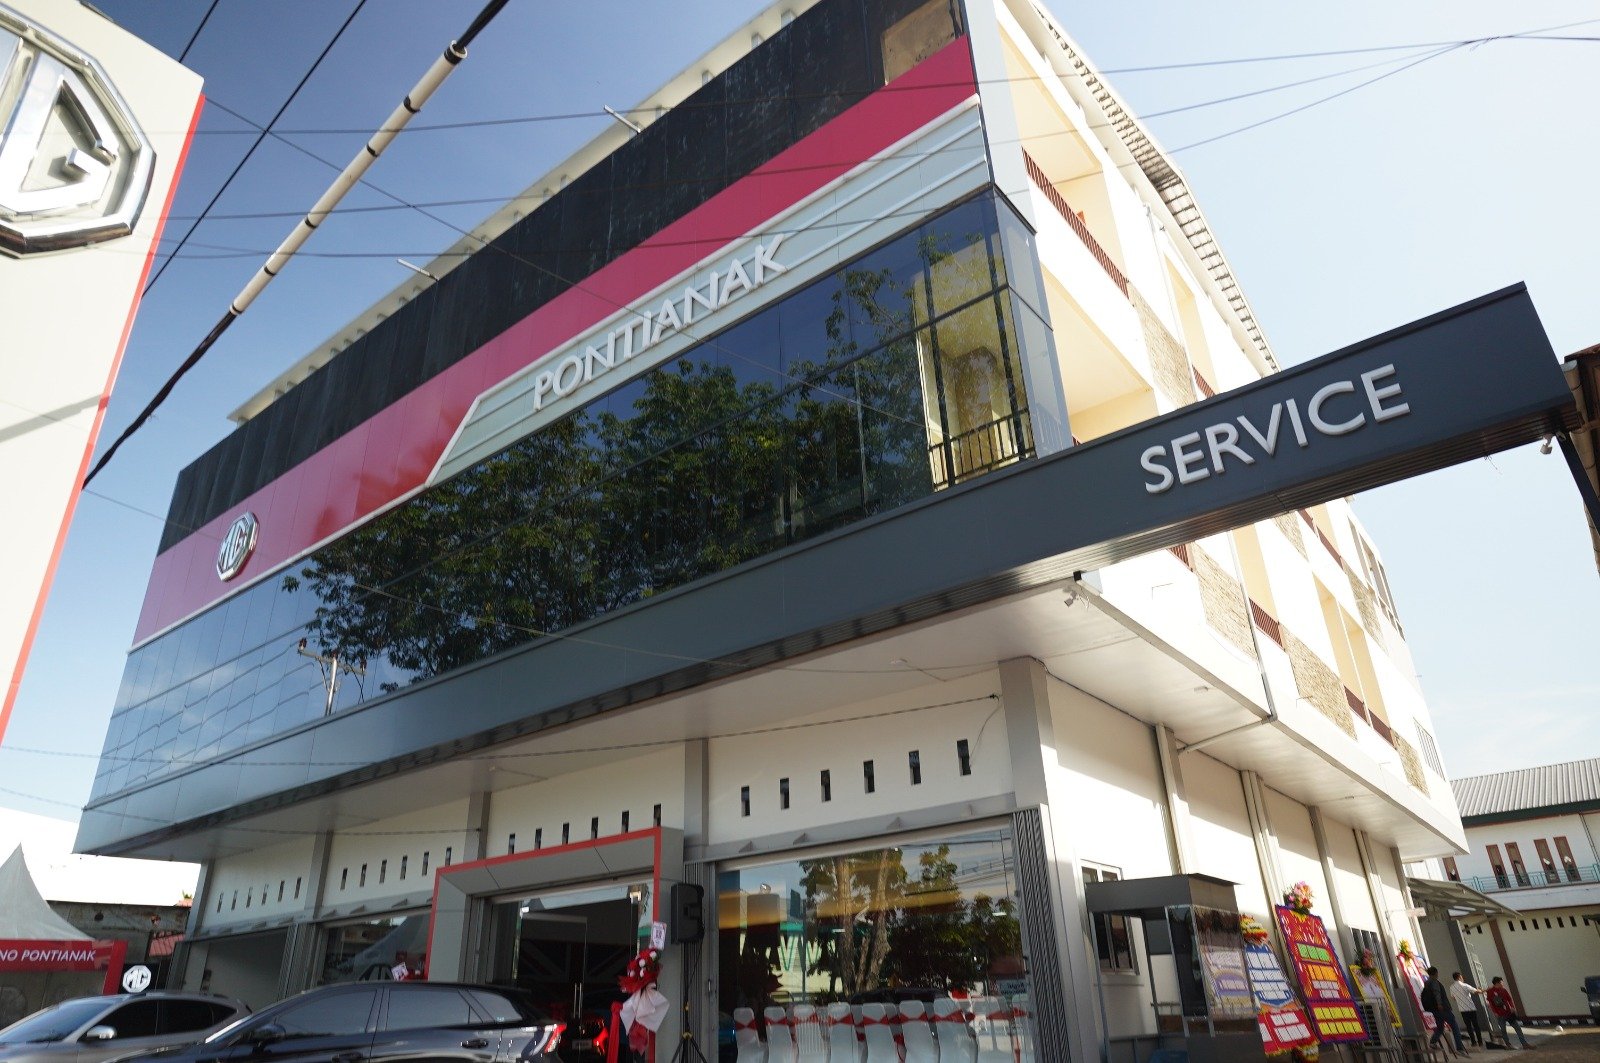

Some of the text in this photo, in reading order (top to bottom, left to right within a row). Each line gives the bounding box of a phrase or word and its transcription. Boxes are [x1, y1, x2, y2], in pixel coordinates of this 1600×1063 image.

[533, 233, 788, 410] PONTIANAK
[1140, 363, 1410, 493] SERVICE
[218, 515, 251, 574] MG
[21, 949, 96, 962] PONTIANAK
[124, 968, 149, 990] MG
